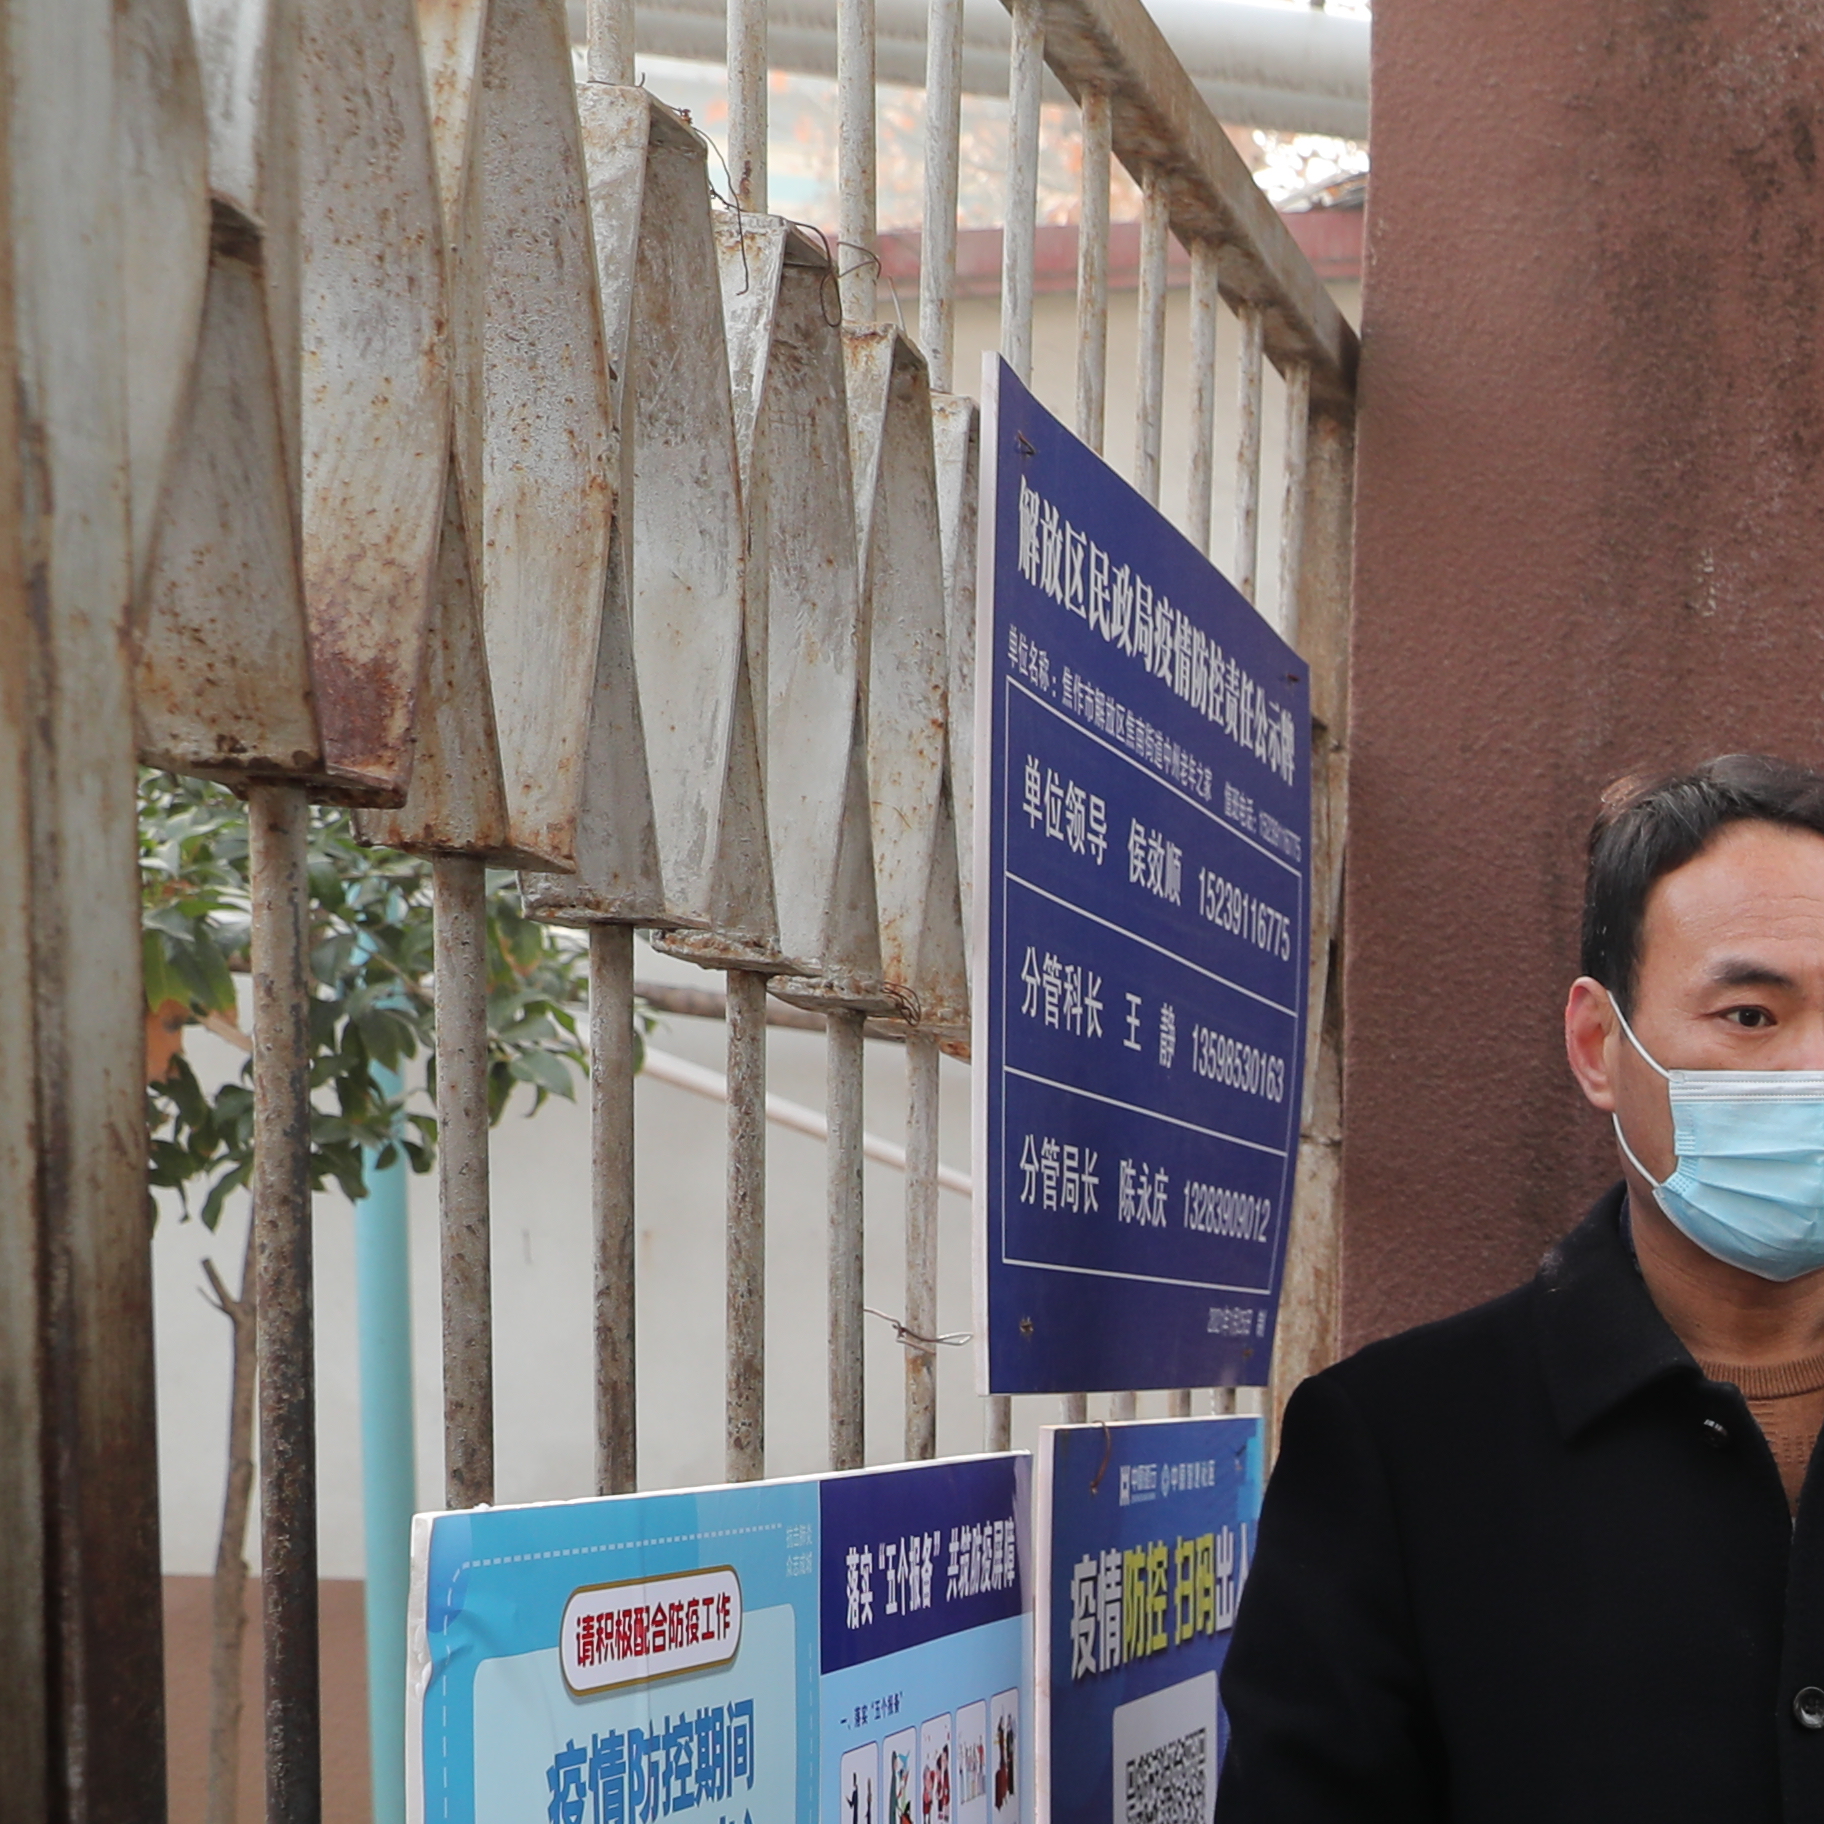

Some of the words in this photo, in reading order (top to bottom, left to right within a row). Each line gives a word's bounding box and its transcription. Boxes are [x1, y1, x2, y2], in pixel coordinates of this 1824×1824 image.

[1018, 474, 1295, 787] 解放区民政局疫情防控责任公示牌
[1023, 754, 1107, 865] 单位领导
[1128, 818, 1182, 906] 侯效顺
[1199, 867, 1290, 961] 15239116775
[1021, 946, 1103, 1038] 分管科长
[1192, 1024, 1285, 1103] 13598530163
[1019, 1134, 1099, 1214] 分管局长
[1118, 1158, 1169, 1228] 陈永庆
[1184, 1180, 1271, 1243] 13283909012
[946, 1516, 1015, 1602] 共筑防疫屏障
[1071, 1540, 1168, 1680] 疫情防控
[575, 1591, 731, 1668] 请积极配合防疫工作
